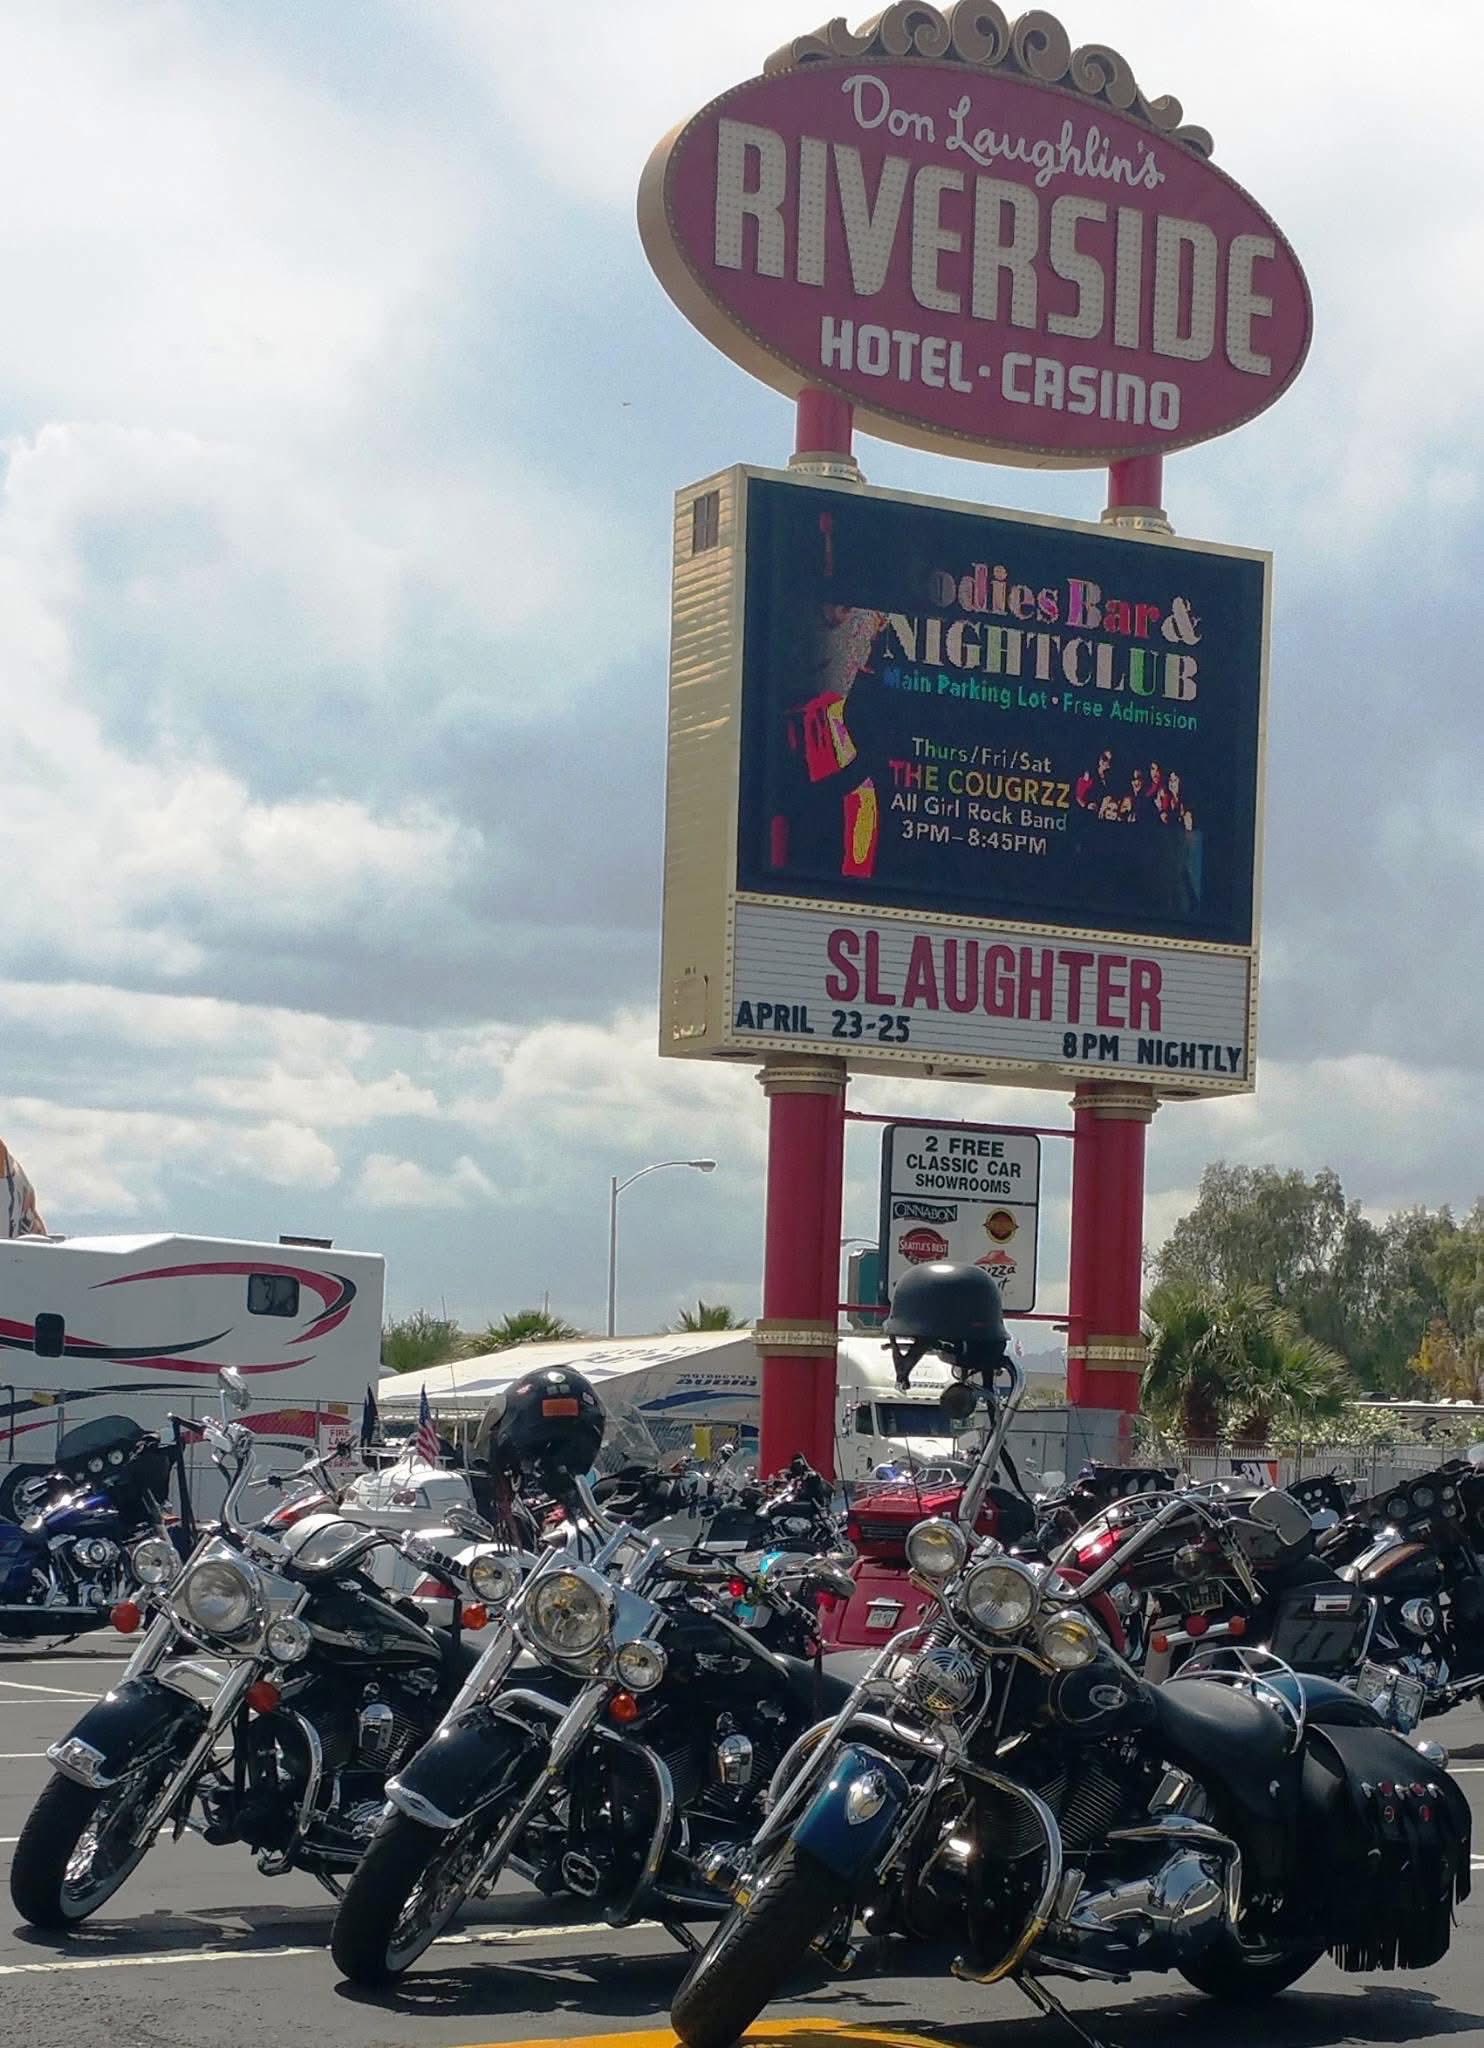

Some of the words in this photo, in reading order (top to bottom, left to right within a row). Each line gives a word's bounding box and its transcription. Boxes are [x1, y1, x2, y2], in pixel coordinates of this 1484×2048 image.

[842, 75, 935, 142] Don
[946, 96, 1166, 188] Laughlin's
[714, 117, 1277, 377] RIVERSIDE
[820, 315, 972, 393] HOTEL
[1002, 351, 1182, 431] CASINO
[1065, 578, 1161, 638] Bar
[883, 611, 1198, 701] NIGHTCLUB
[937, 674, 1011, 709] Parking
[1018, 686, 1047, 708] Lot
[1063, 693, 1103, 717] Free
[1110, 701, 1197, 730] Admission
[889, 760, 939, 792] THE
[948, 770, 1071, 808] COUGRZZ
[890, 793, 917, 812] All
[924, 797, 960, 818] Girl
[968, 803, 1013, 825] Rock
[1021, 809, 1068, 831] Band
[825, 929, 1163, 1032] SLAUGHTER
[736, 1001, 814, 1033] APRIL
[832, 1010, 911, 1043] 23-25
[1137, 1039, 1242, 1073] NIGHTLY
[906, 1154, 978, 1174] CLASSIC
[987, 1161, 1021, 1178] CAR
[925, 1136, 938, 1152] 2
[949, 1138, 1004, 1157] FREE
[915, 1174, 1011, 1194] SHOWROOMS
